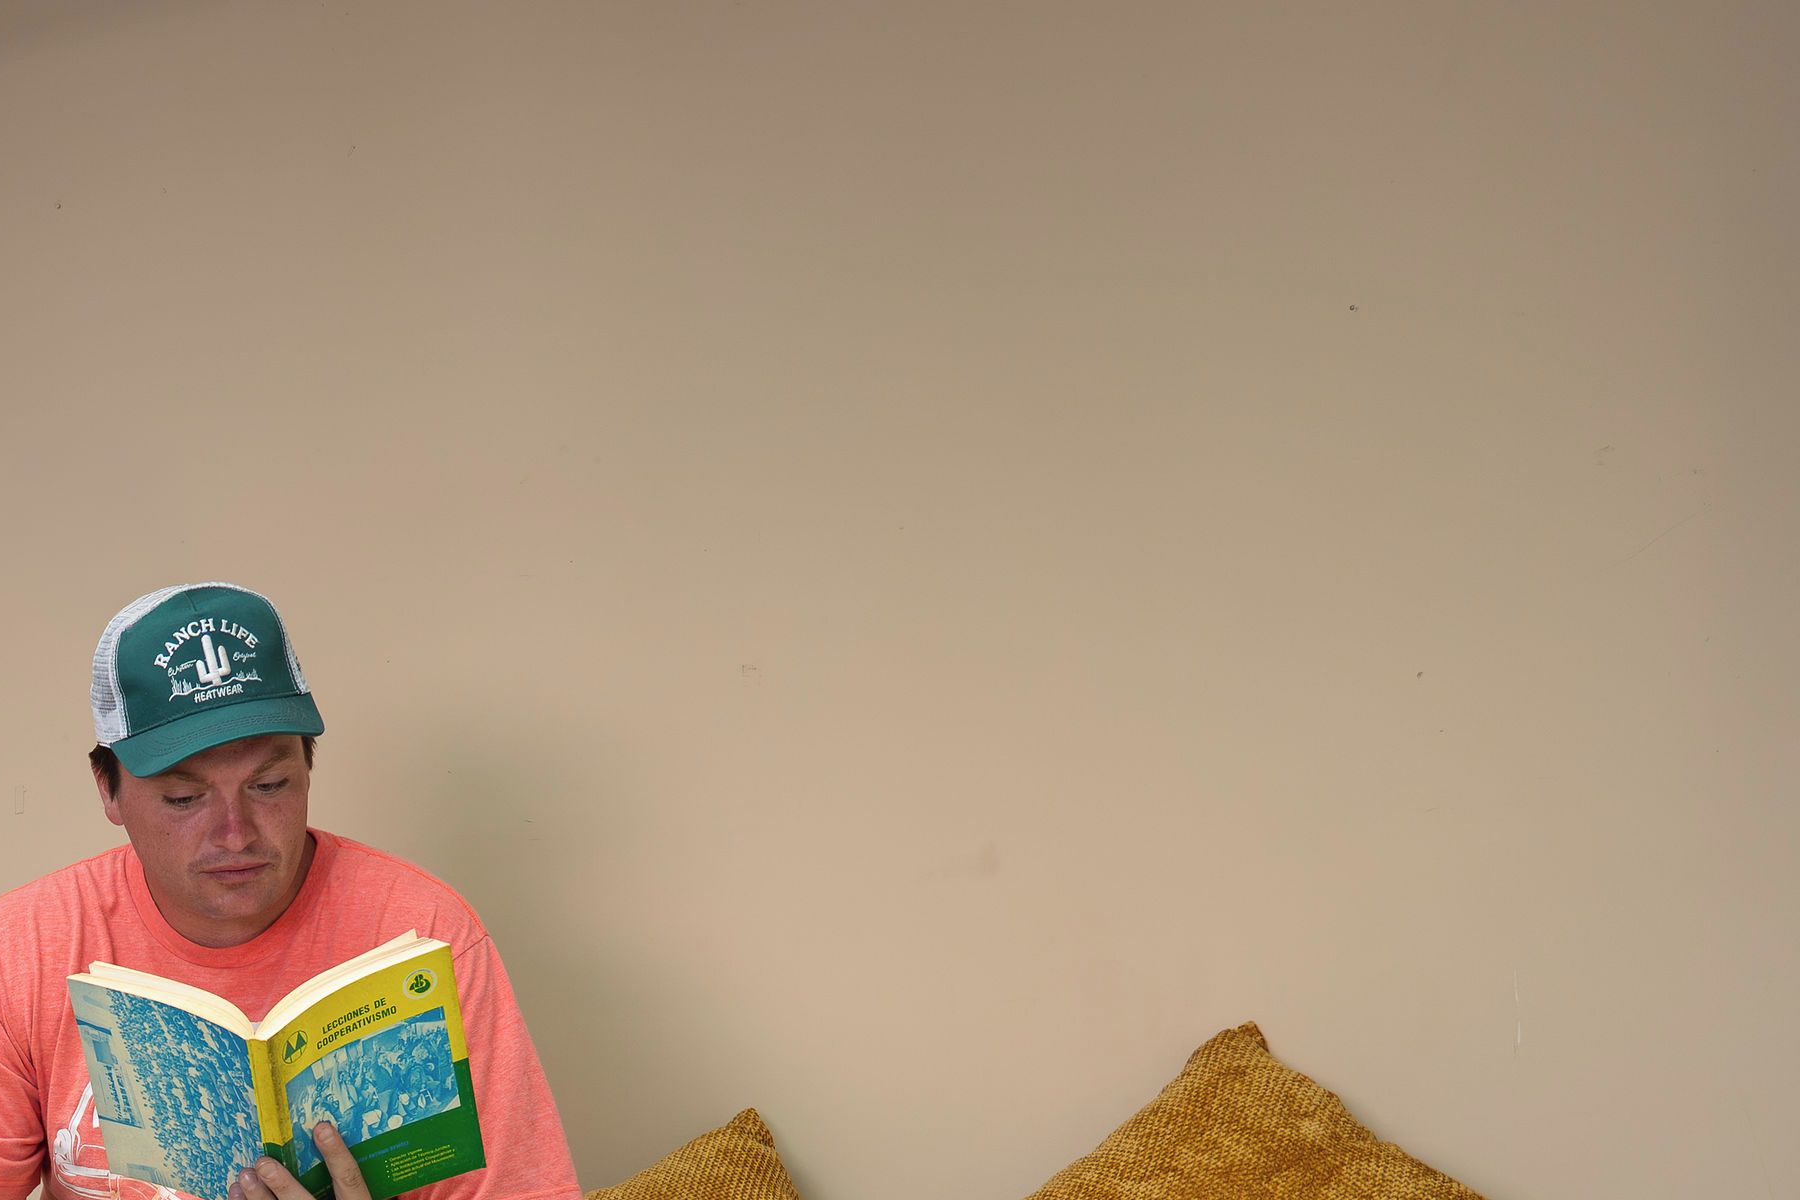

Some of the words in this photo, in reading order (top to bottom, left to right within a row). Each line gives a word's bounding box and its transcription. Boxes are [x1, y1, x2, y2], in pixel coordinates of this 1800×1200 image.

[154, 618, 215, 668] RANCH
[221, 619, 259, 648] LIFE
[194, 684, 244, 704] HEATWEAR
[317, 1006, 397, 1050] COOPERATIVISMO
[323, 1005, 370, 1035] LECCIONES
[374, 998, 387, 1009] DE
